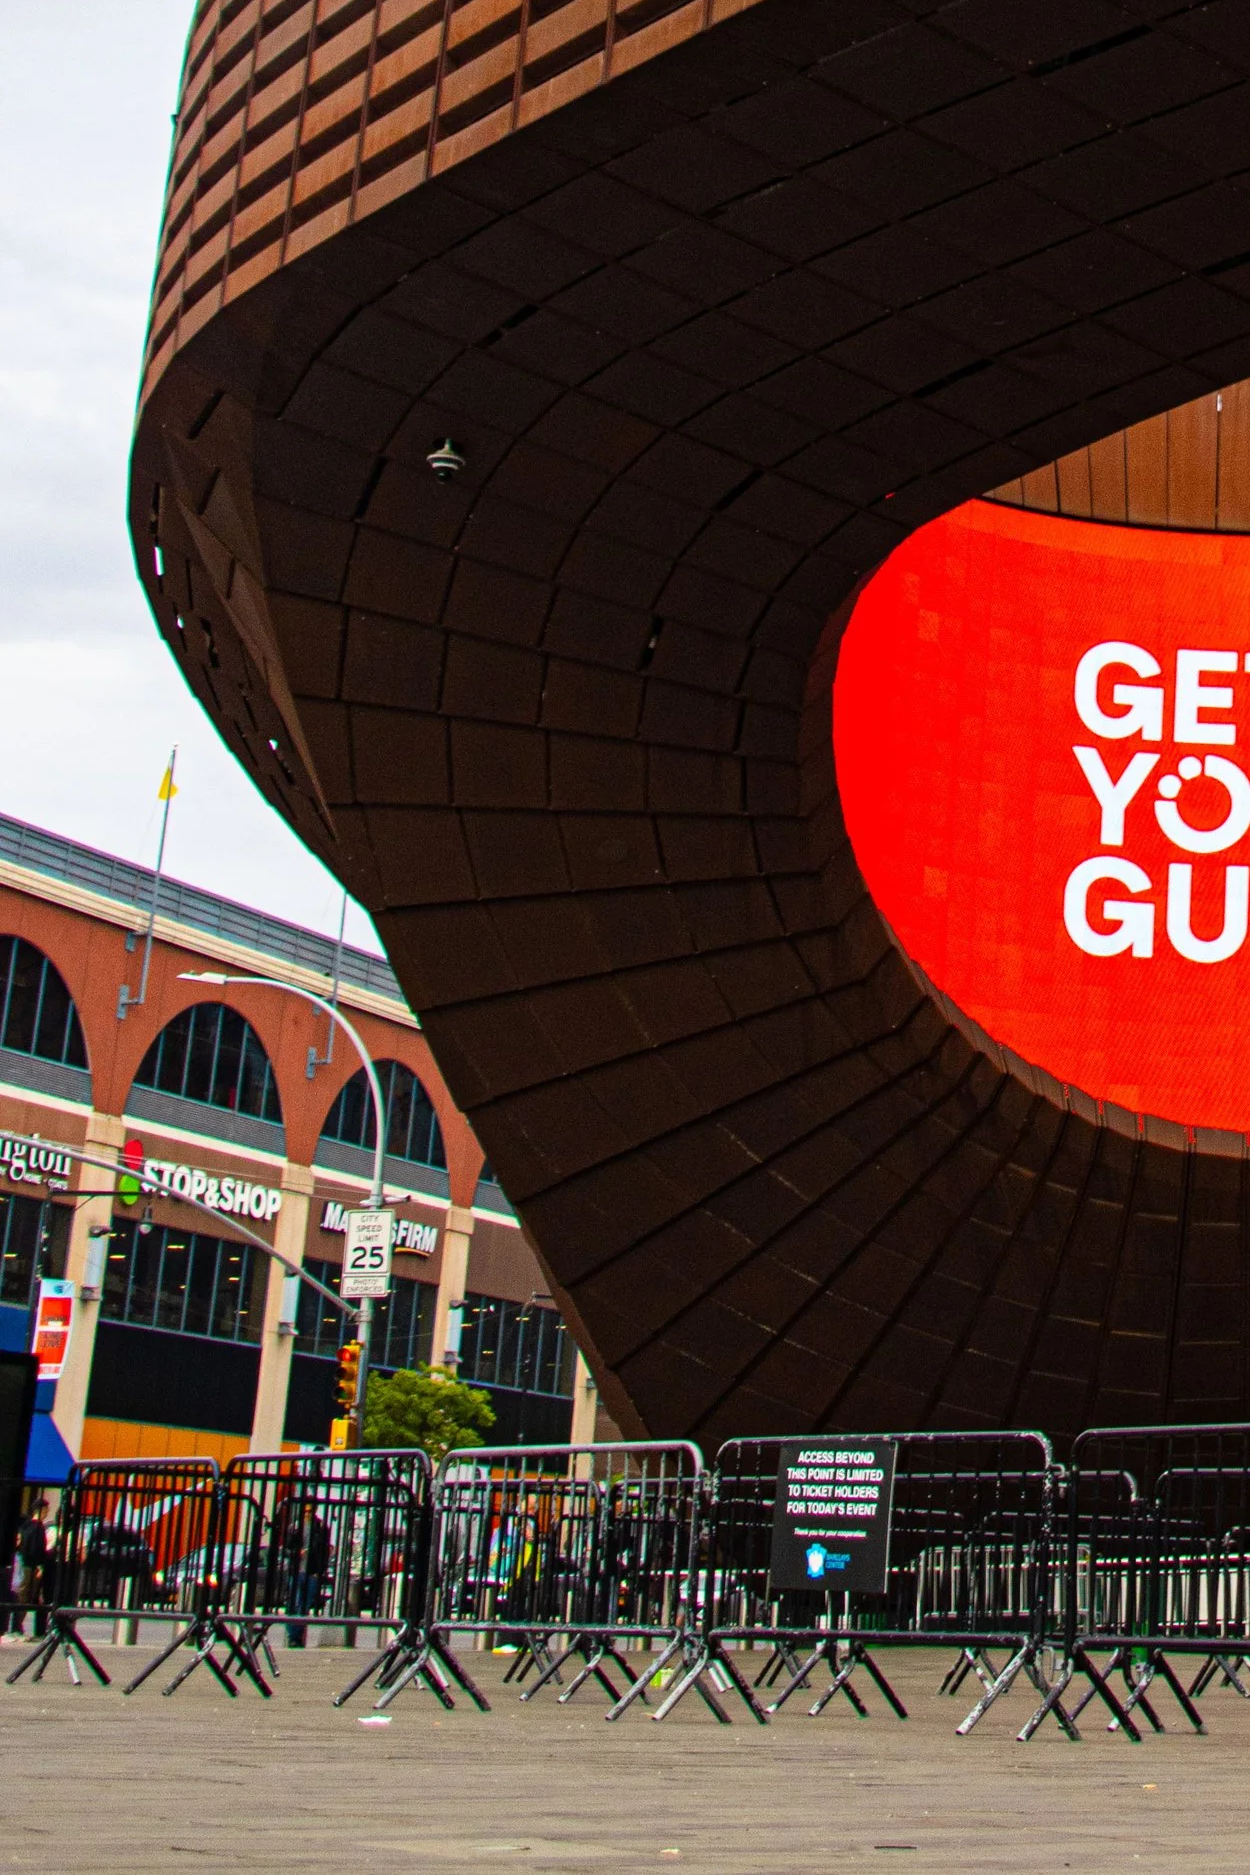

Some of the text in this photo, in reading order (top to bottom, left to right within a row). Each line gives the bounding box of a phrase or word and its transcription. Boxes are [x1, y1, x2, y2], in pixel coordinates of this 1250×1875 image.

[360, 1215, 379, 1223] CITY
[355, 1224, 383, 1233] SPEED
[358, 1234, 380, 1243] LIMIT
[350, 1246, 384, 1269] 25
[797, 1451, 875, 1464] ACCESS BEYOND
[787, 1468, 884, 1481] THIS POINT IS LIMITED
[788, 1485, 879, 1498] TO TICKET HOLDERS
[786, 1502, 878, 1515] FOR TODAY'S EVENT
